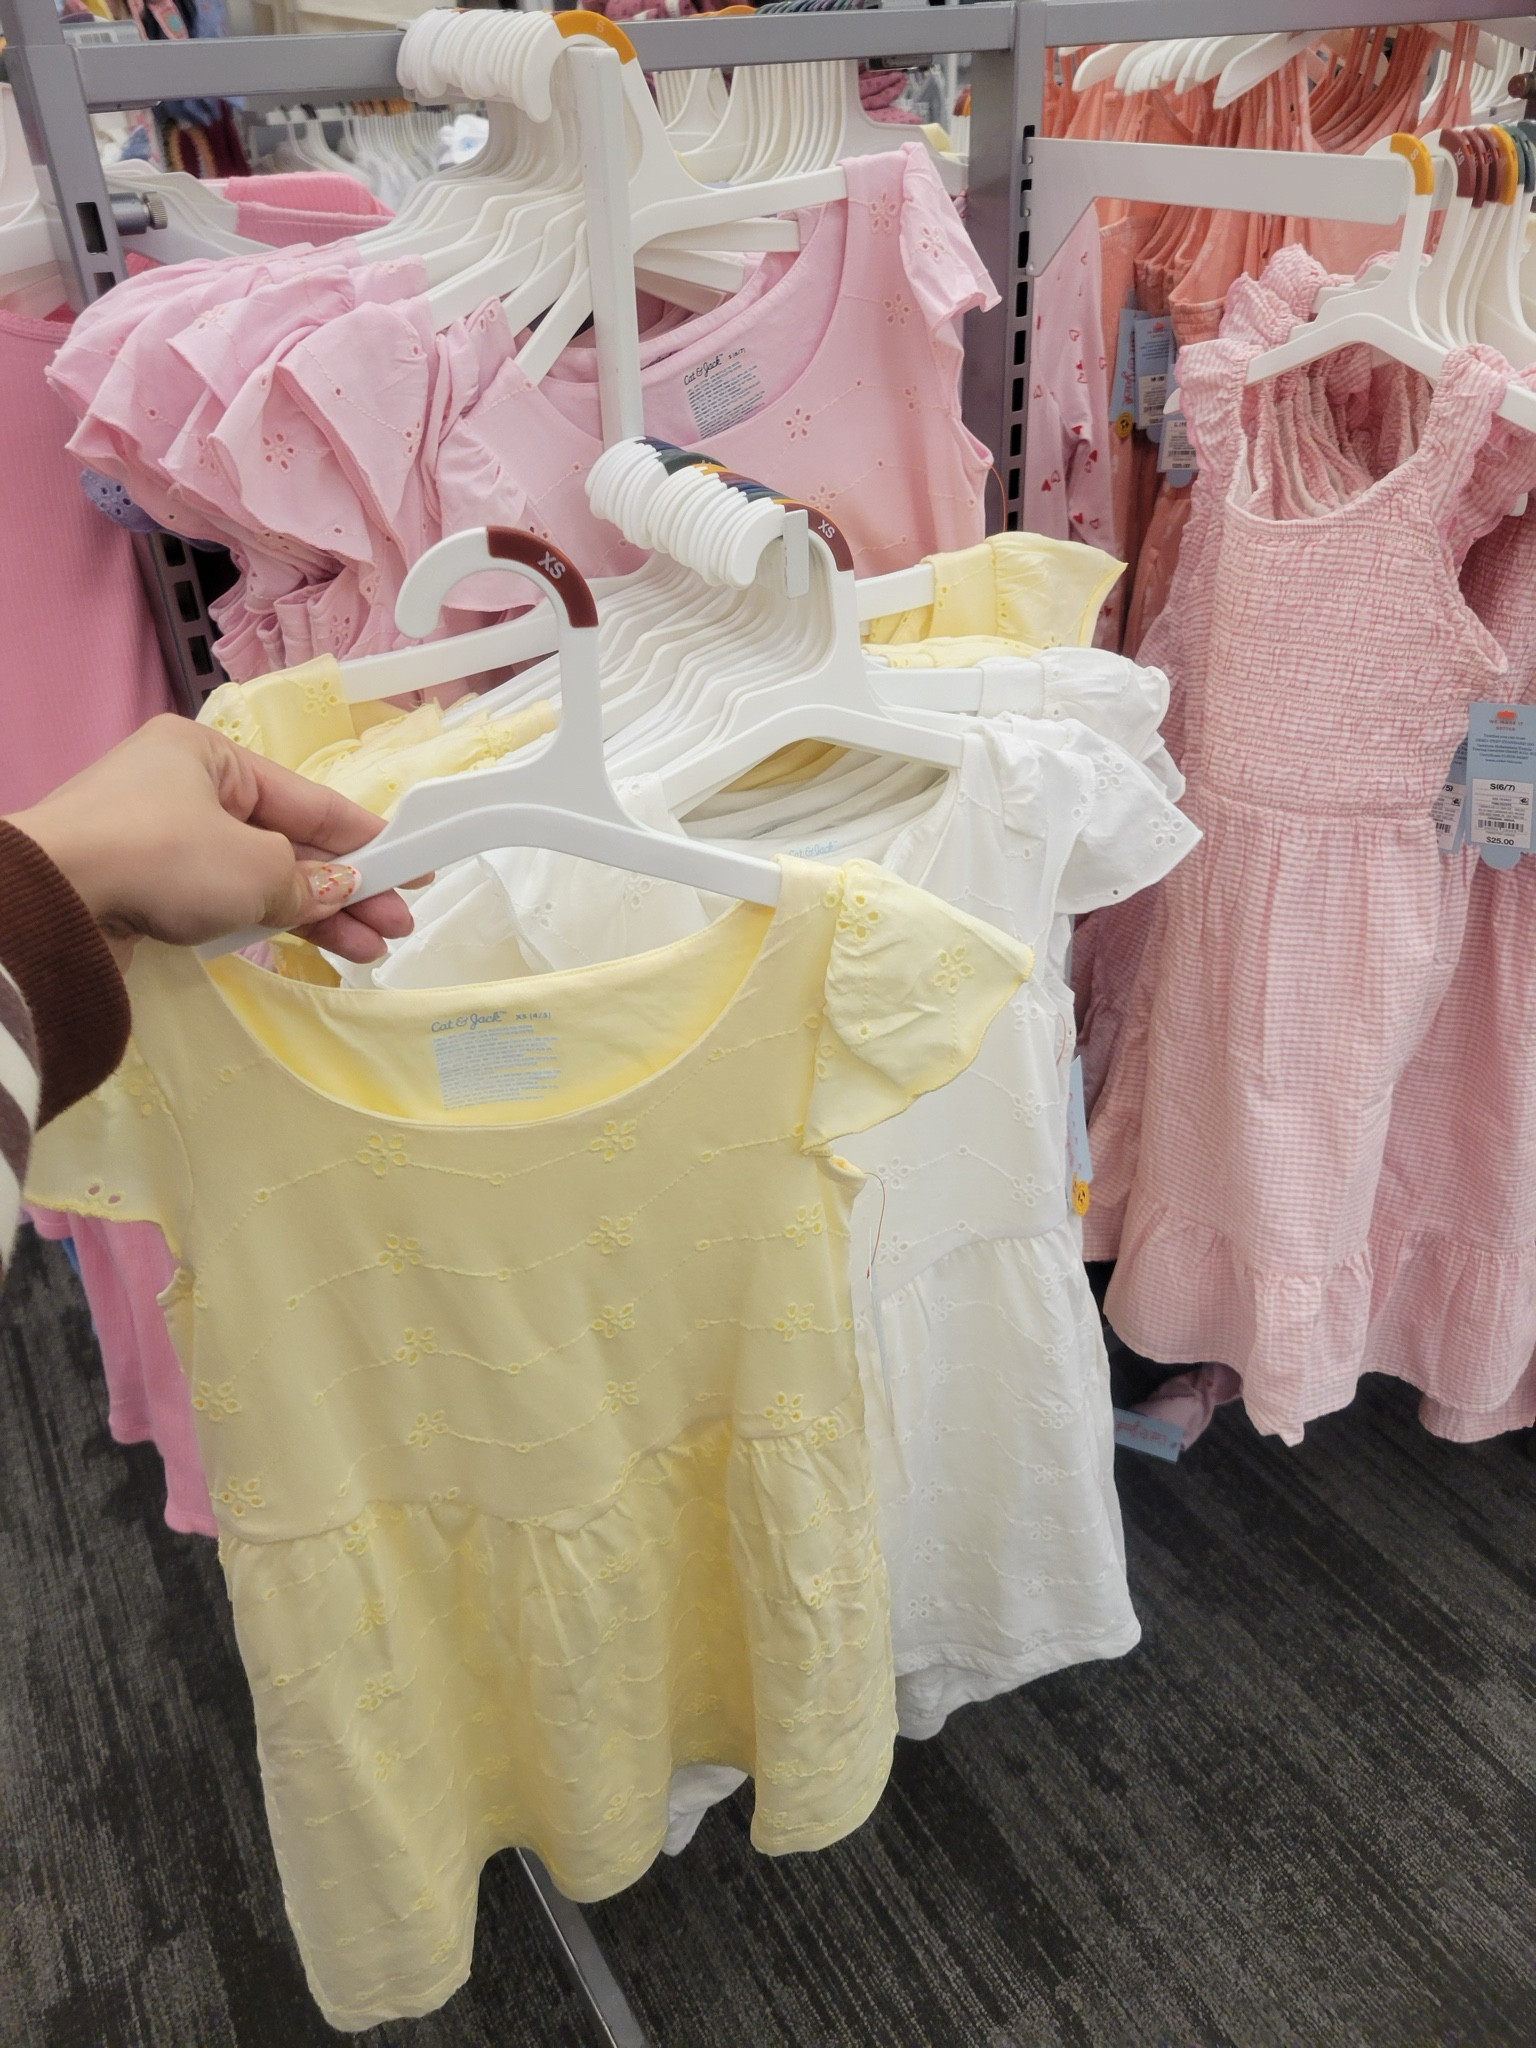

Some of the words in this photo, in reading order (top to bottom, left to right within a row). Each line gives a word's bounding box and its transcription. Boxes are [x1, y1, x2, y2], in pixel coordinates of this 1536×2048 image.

[684, 373, 696, 386] Cat
[696, 367, 703, 377] &
[703, 355, 722, 378] Jack
[818, 519, 835, 539] XS
[537, 550, 566, 580] XS
[1490, 782, 1516, 792] S(6/7)
[1486, 836, 1515, 846] $25.00
[431, 1020, 453, 1032] Cat
[455, 1016, 469, 1027] &
[469, 1011, 502, 1031] Jack
